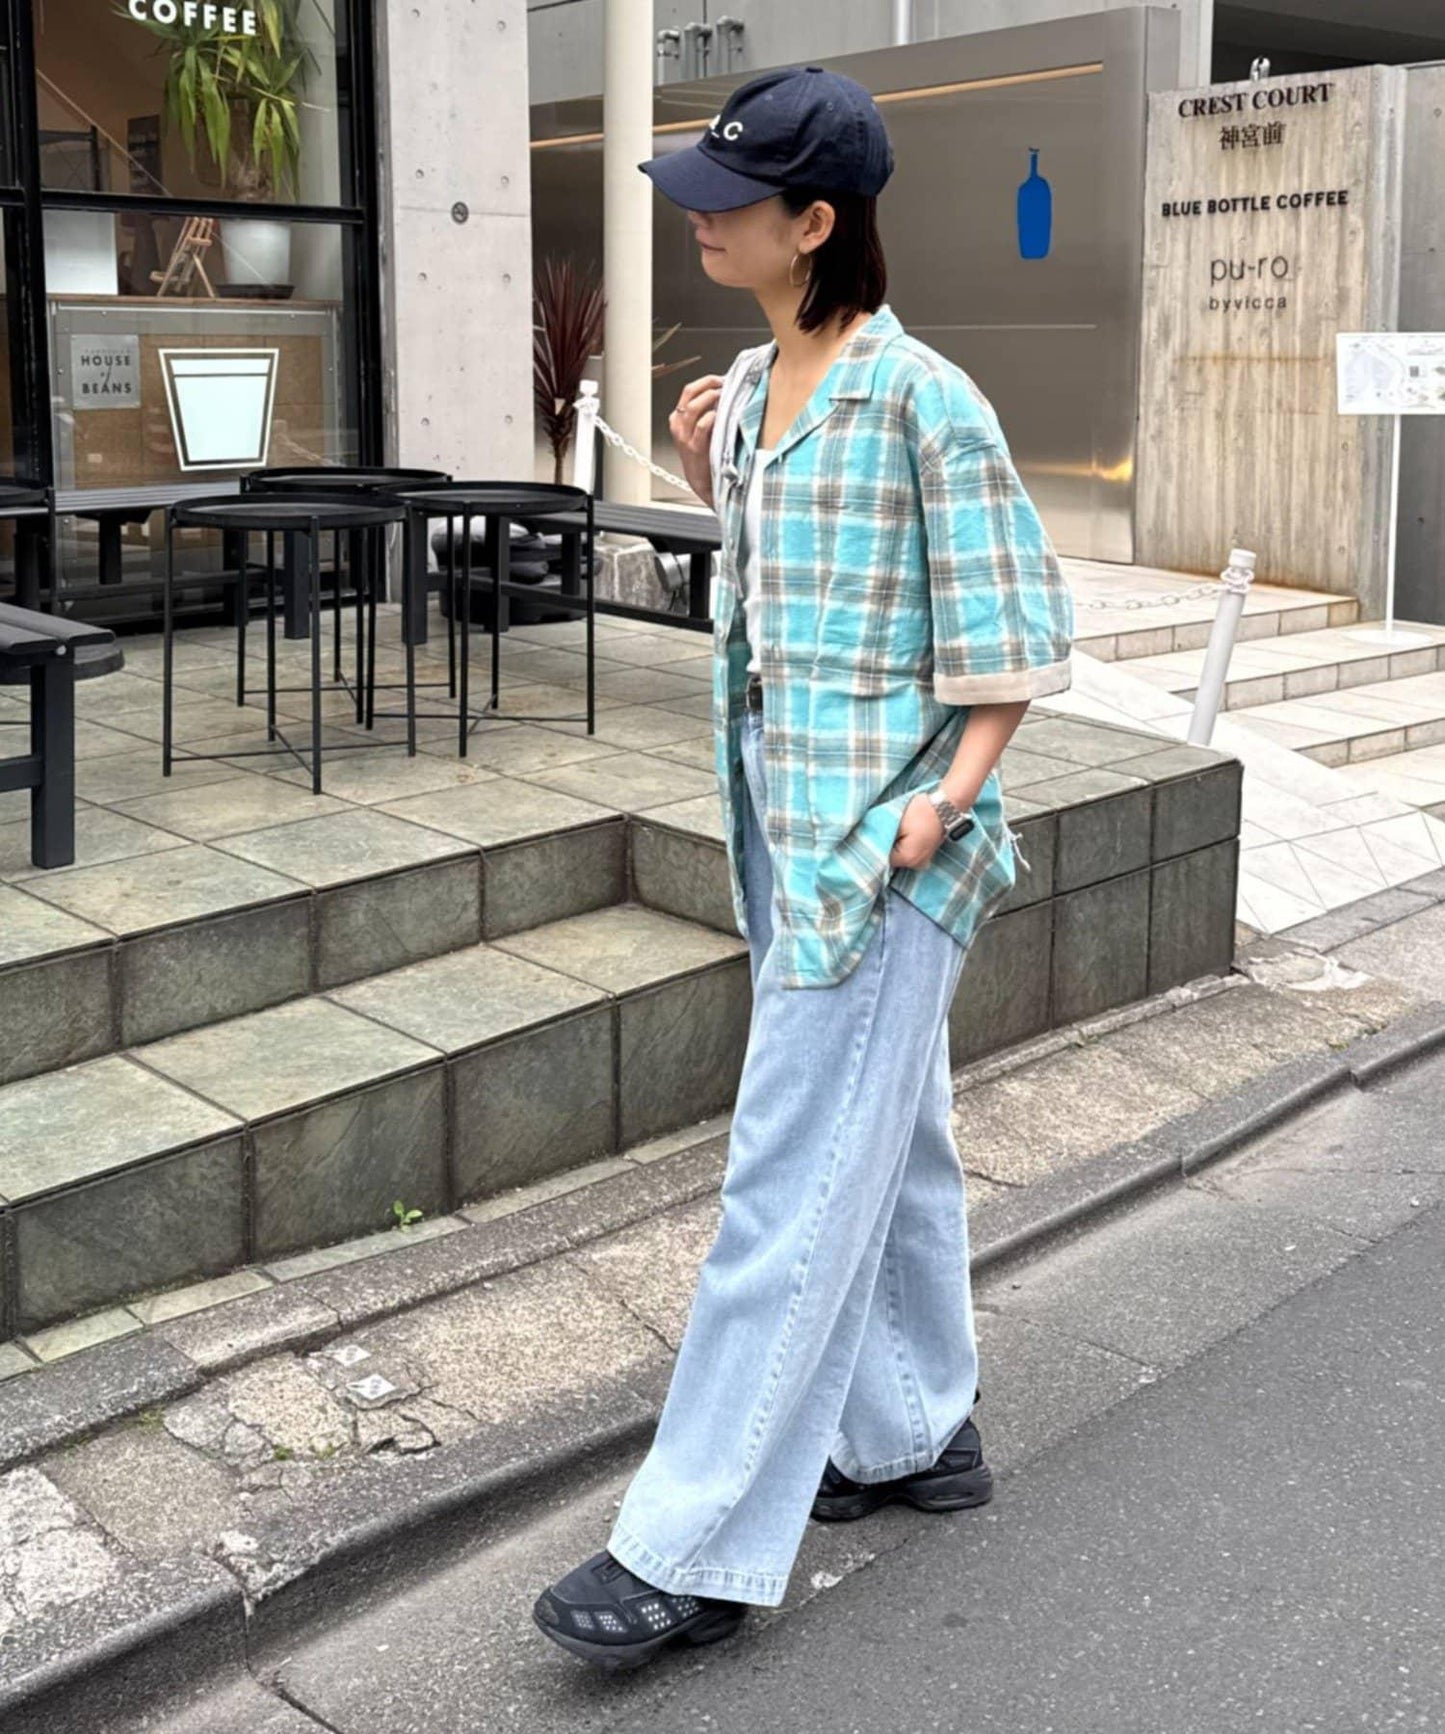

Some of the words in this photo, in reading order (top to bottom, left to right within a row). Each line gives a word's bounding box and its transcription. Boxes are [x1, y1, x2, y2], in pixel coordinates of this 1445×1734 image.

[128, 0, 257, 35] COFFEE
[1178, 92, 1247, 118] CREST
[1252, 83, 1334, 111] COURT
[1220, 121, 1286, 150] 神宮前
[1161, 200, 1202, 217] BLUE
[1207, 195, 1271, 214] BOTTLE
[1276, 189, 1348, 210] COFFEE
[1210, 256, 1289, 287] pu-ro
[81, 355, 130, 367] HOUSE
[82, 382, 132, 395] BEANS
